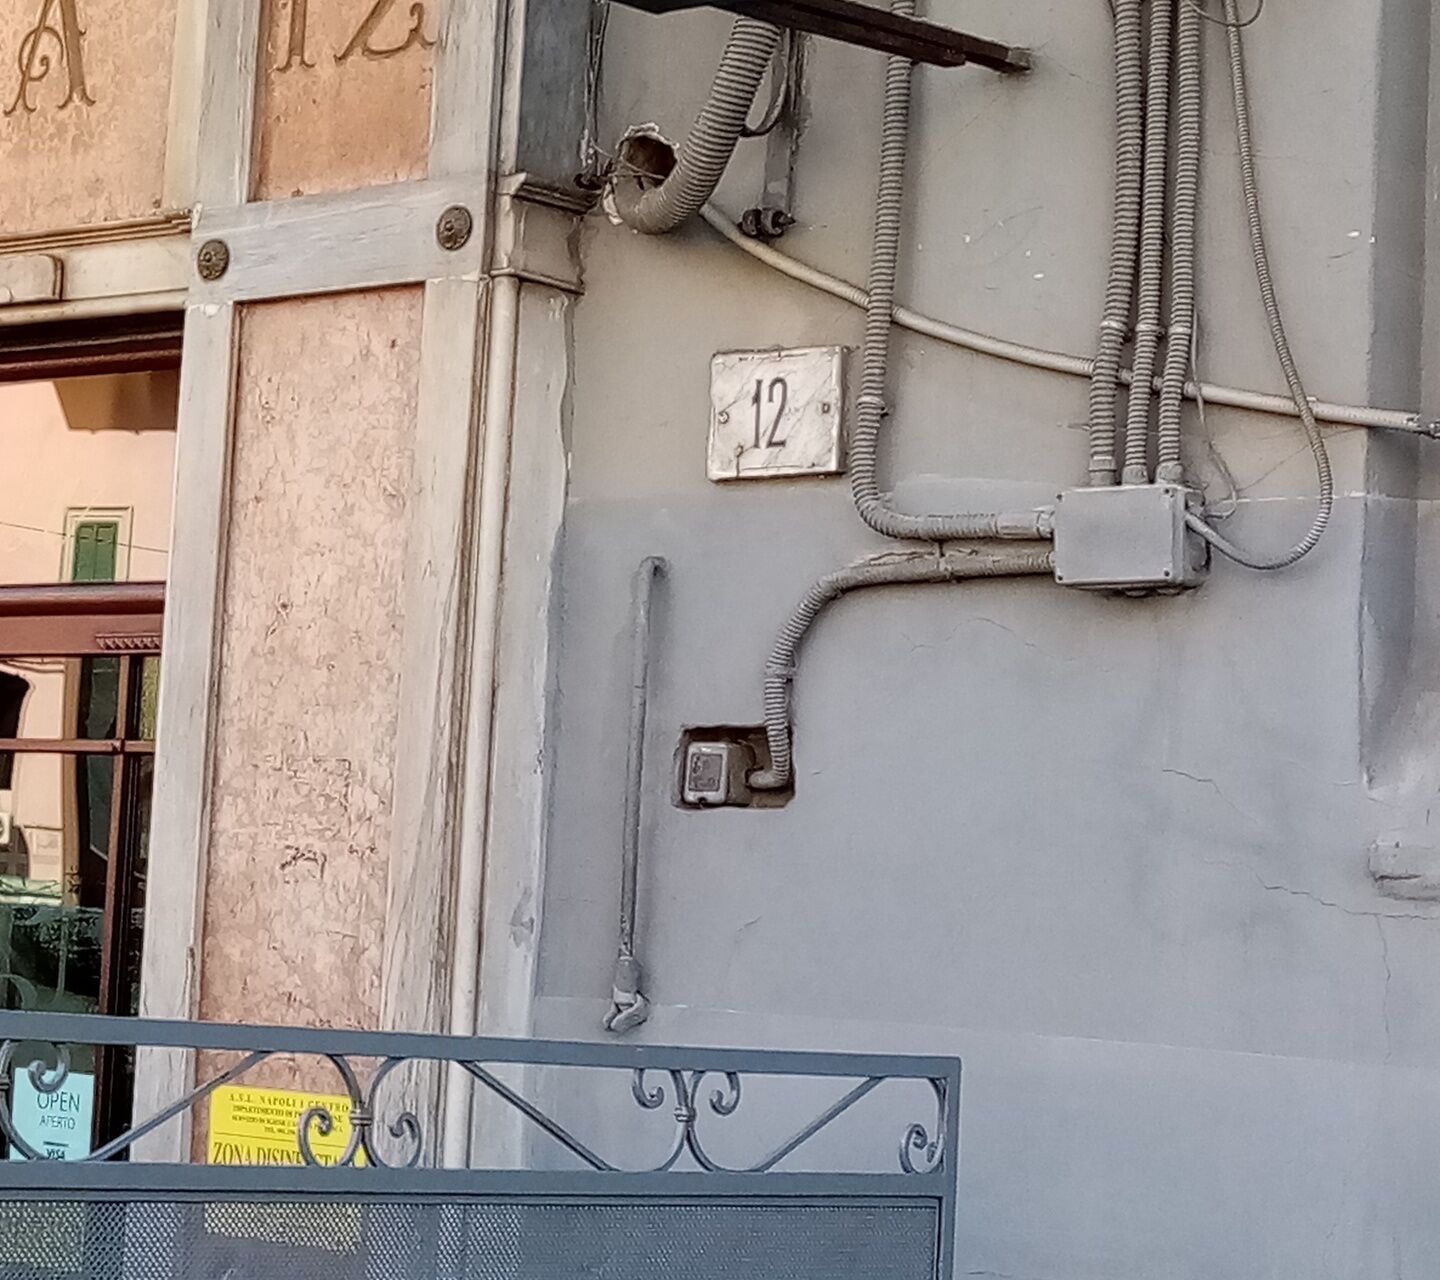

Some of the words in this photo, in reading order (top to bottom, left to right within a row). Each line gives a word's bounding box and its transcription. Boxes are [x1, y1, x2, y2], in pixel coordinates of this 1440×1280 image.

[751, 376, 788, 449] 12
[36, 1090, 80, 1113] OPEN
[259, 1096, 296, 1108] NAPOLI
[213, 1142, 252, 1166] ZONA
